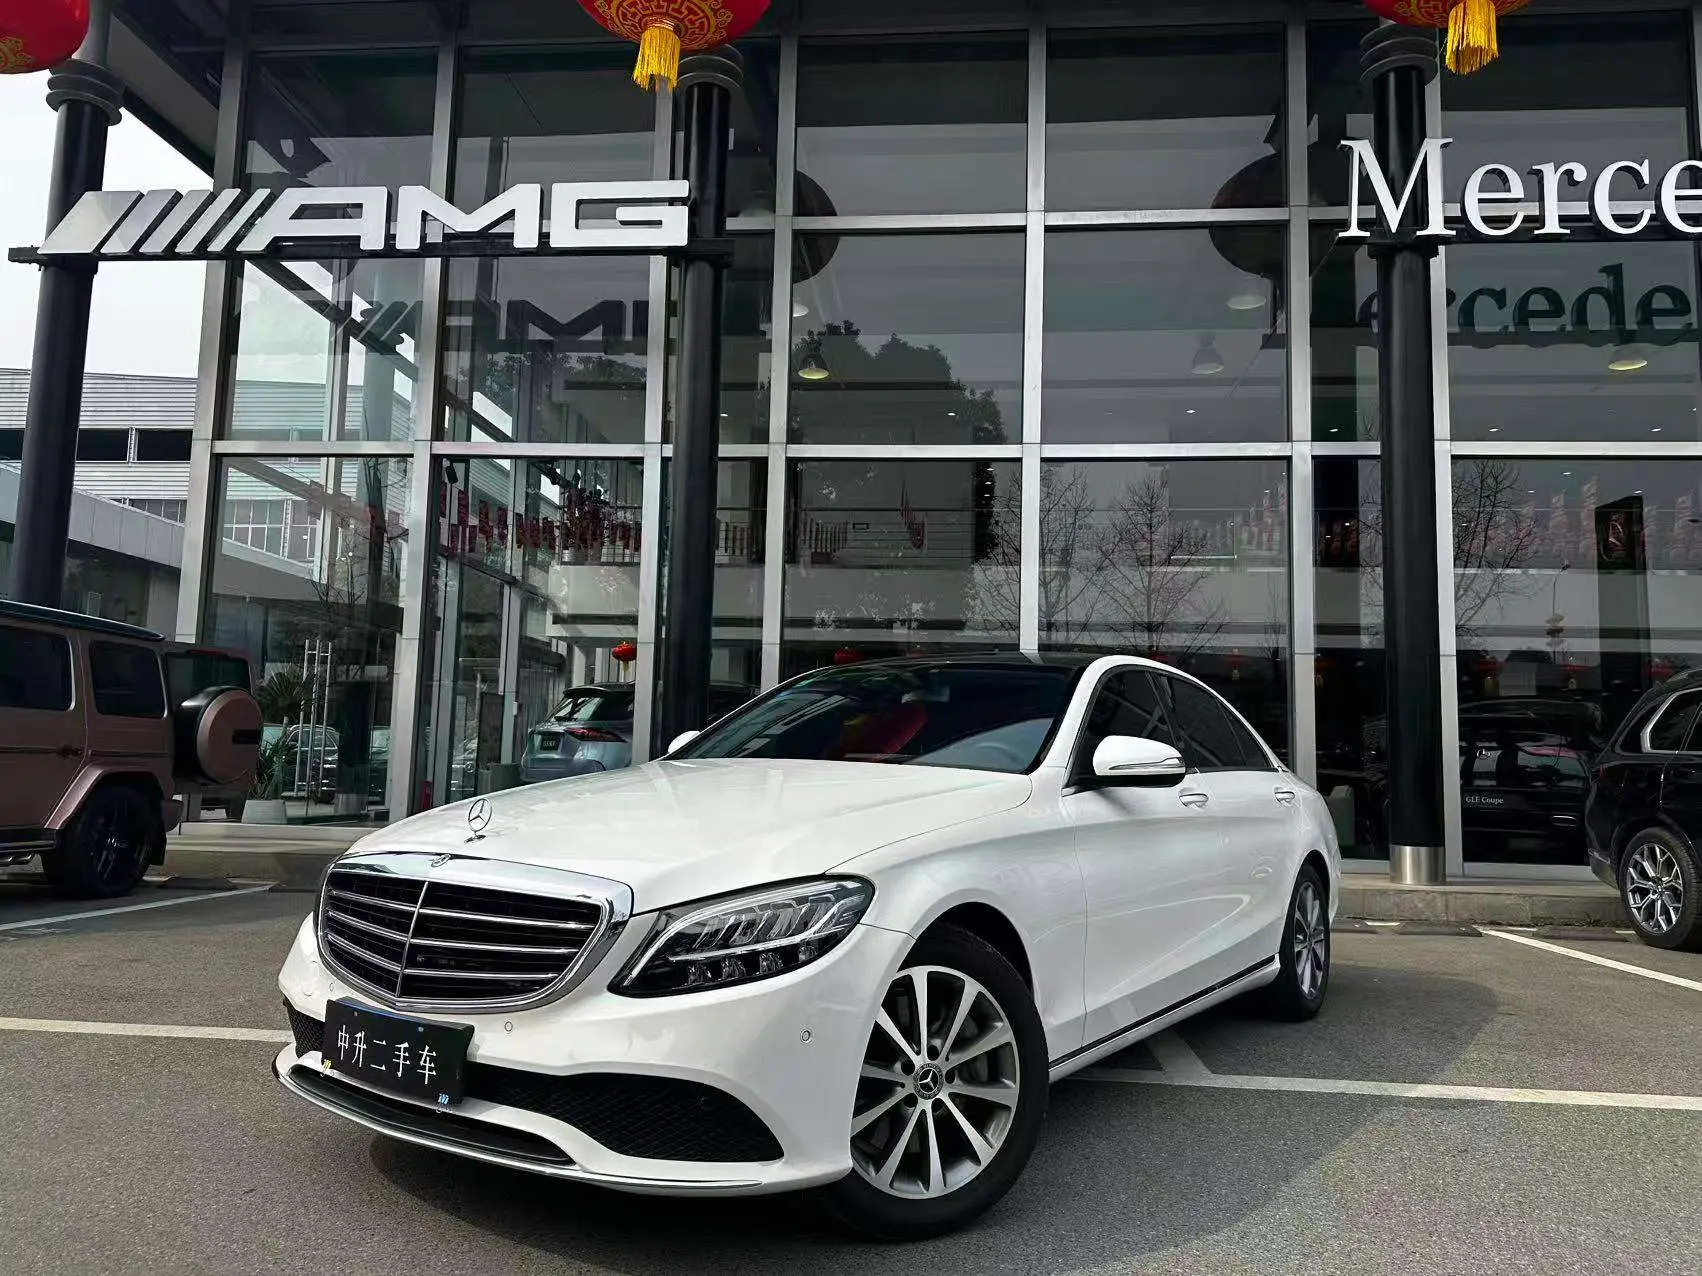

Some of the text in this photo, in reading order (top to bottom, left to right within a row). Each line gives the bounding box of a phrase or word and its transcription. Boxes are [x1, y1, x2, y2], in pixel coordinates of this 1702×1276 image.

[237, 179, 690, 252] AMG
[337, 1024, 437, 1085] 中升二手车
